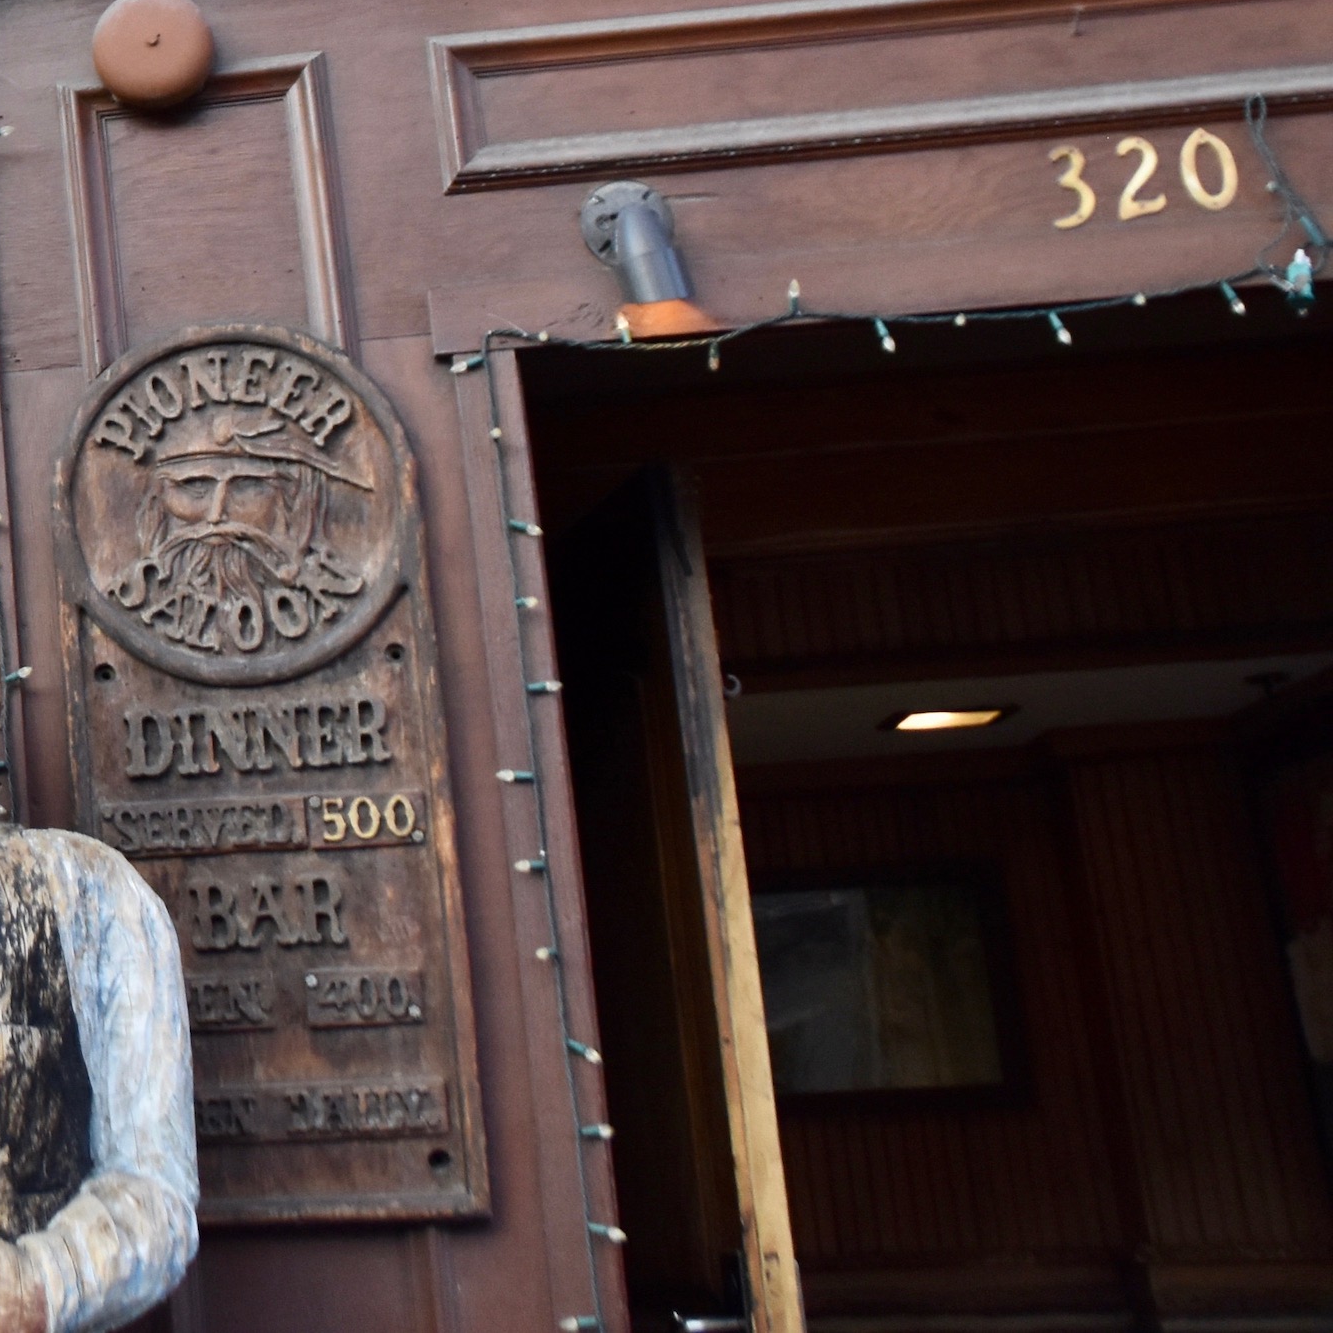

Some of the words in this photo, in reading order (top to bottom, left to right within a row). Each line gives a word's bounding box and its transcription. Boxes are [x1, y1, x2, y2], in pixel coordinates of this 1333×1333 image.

[1048, 127, 1238, 229] 320
[95, 350, 352, 461] PIONEER
[108, 548, 365, 654] SALOON
[124, 698, 392, 778] DINNER
[322, 793, 416, 842] 500
[189, 875, 348, 952] BAR
[189, 977, 272, 1024] EN
